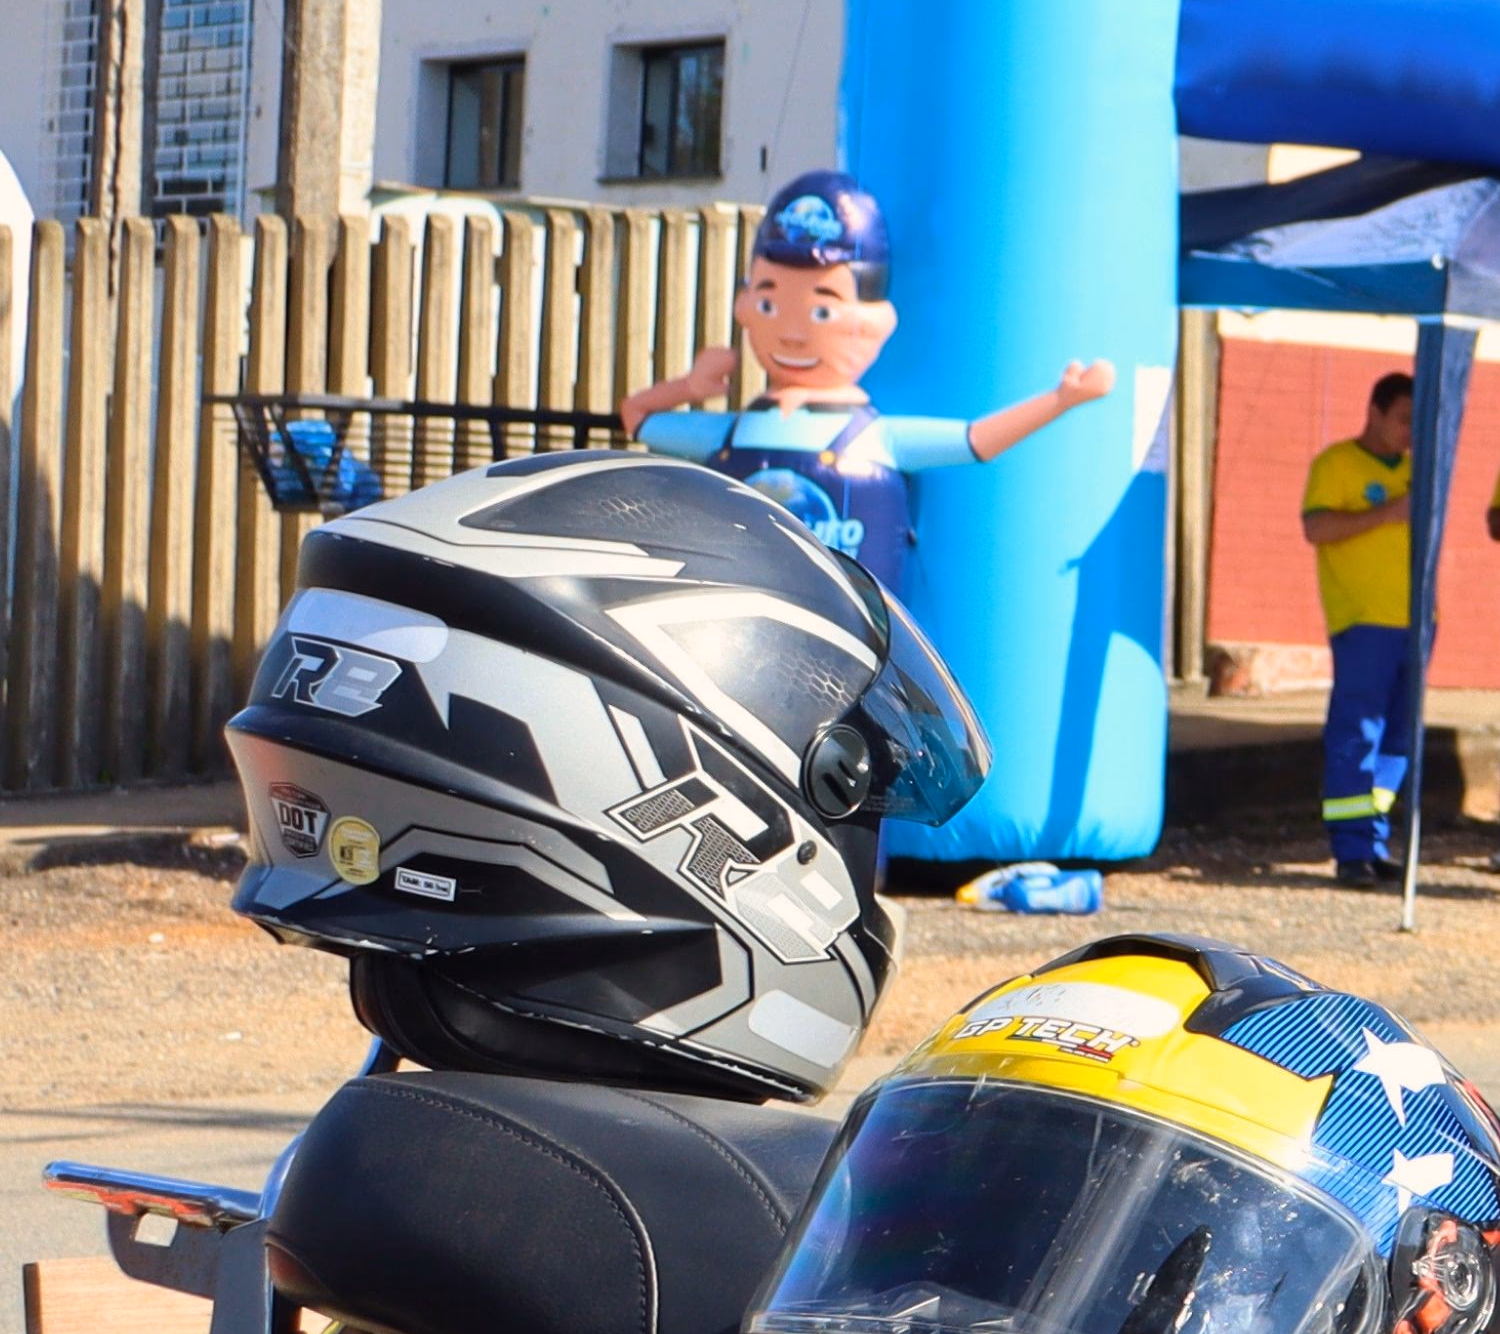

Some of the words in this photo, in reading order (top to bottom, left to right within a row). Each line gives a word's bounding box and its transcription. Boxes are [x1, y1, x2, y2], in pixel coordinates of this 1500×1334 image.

[278, 801, 318, 835] DOT
[953, 1017, 1014, 1040] GP
[1014, 1016, 1134, 1053] TECH
